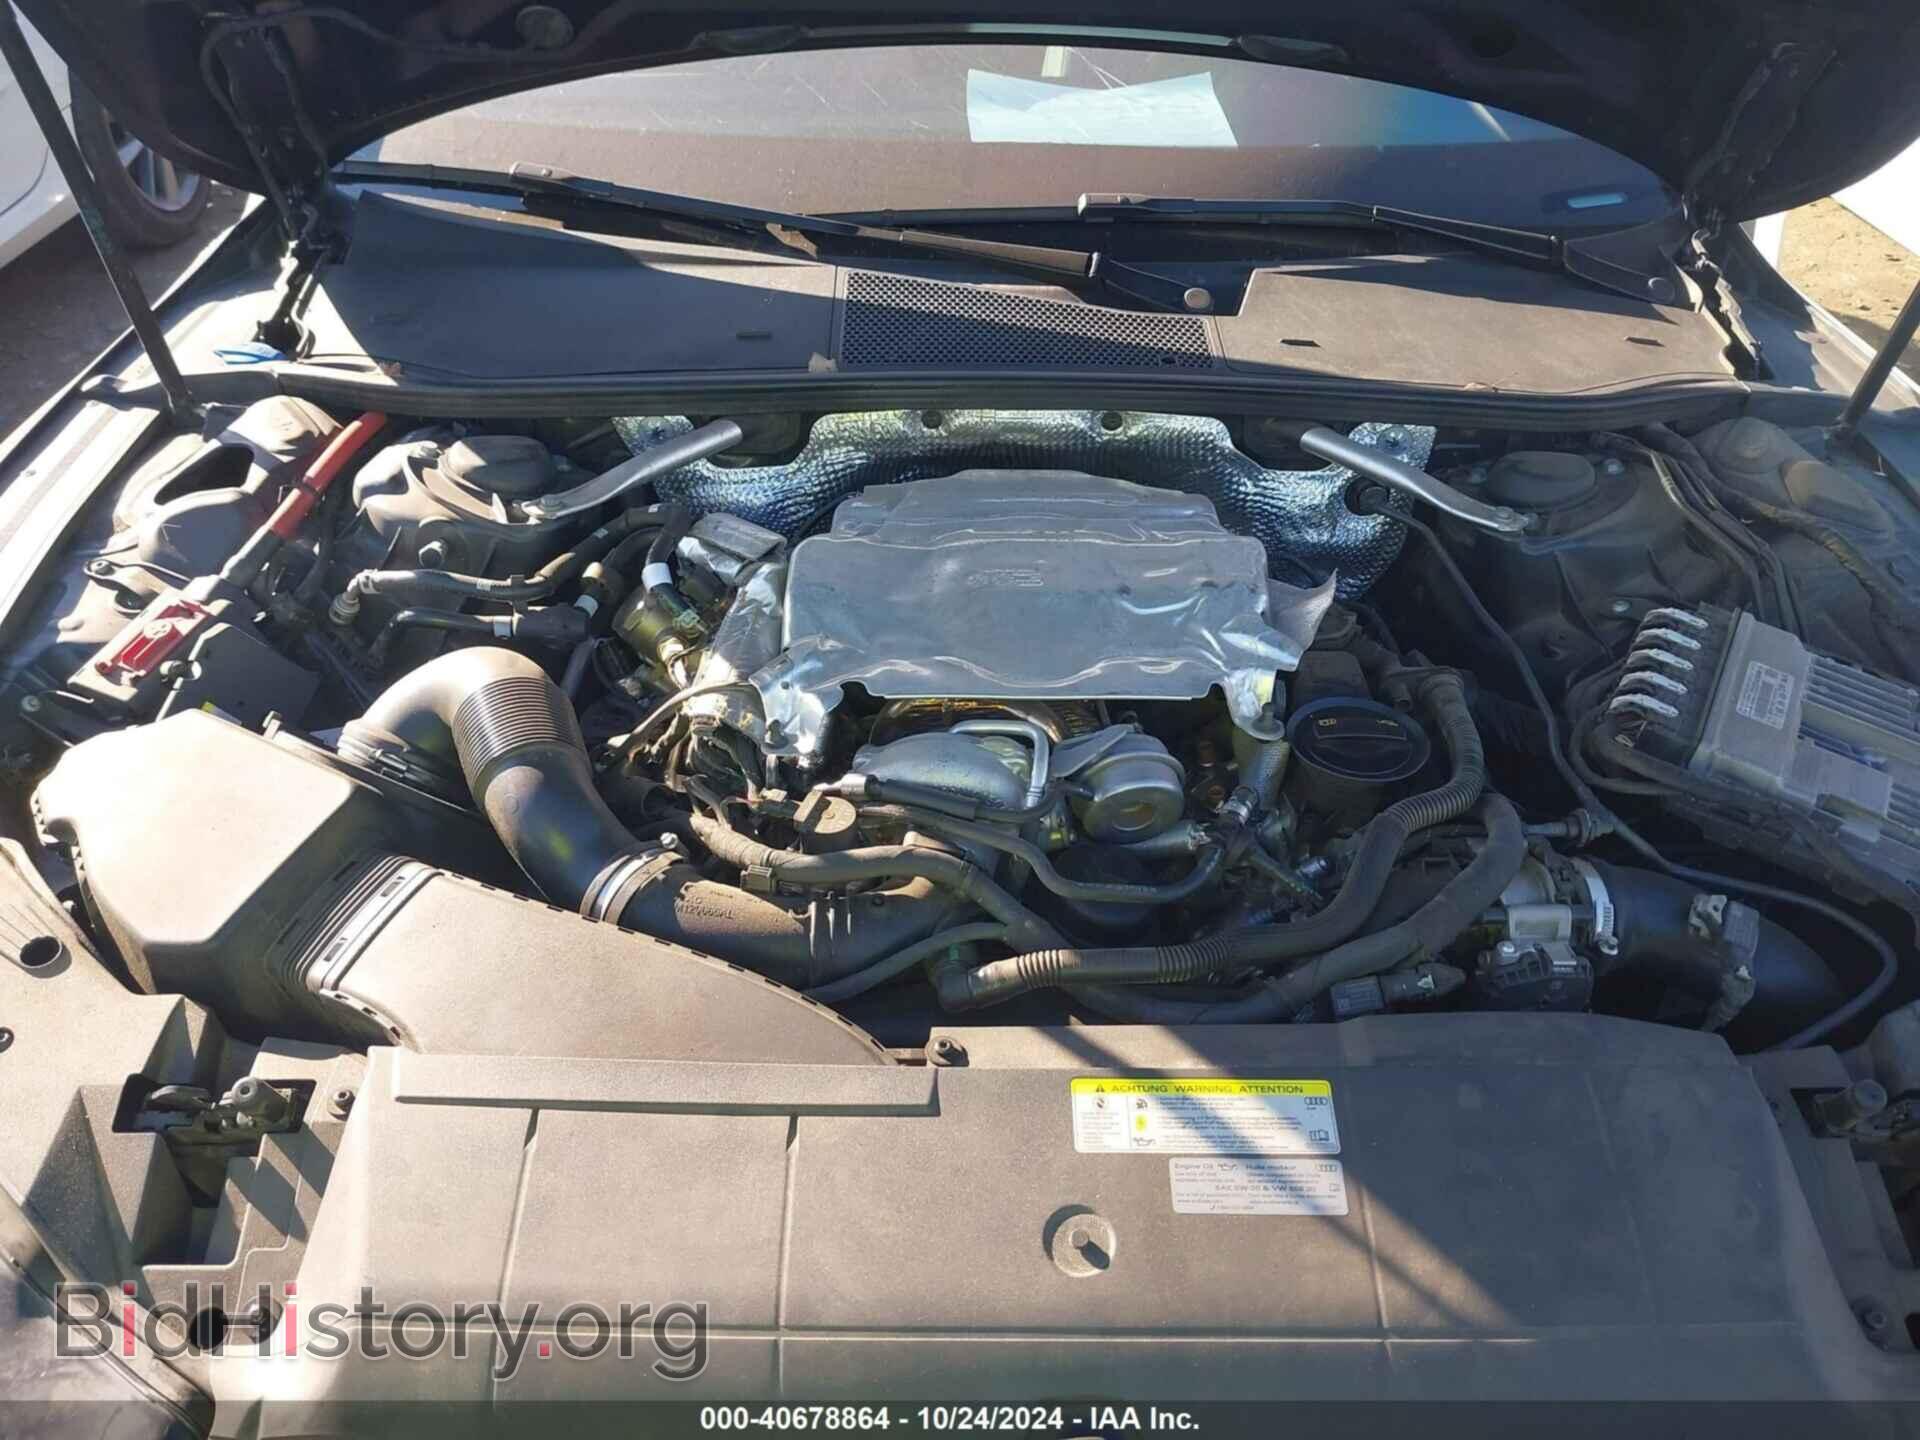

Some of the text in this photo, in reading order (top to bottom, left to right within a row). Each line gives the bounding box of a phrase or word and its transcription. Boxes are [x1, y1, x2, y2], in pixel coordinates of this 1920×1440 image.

[1112, 1084, 1304, 1095] ACHTUNG WARNING ATTENTION
[1174, 1163, 1200, 1171] Engine
[1271, 1184, 1287, 1192] VW
